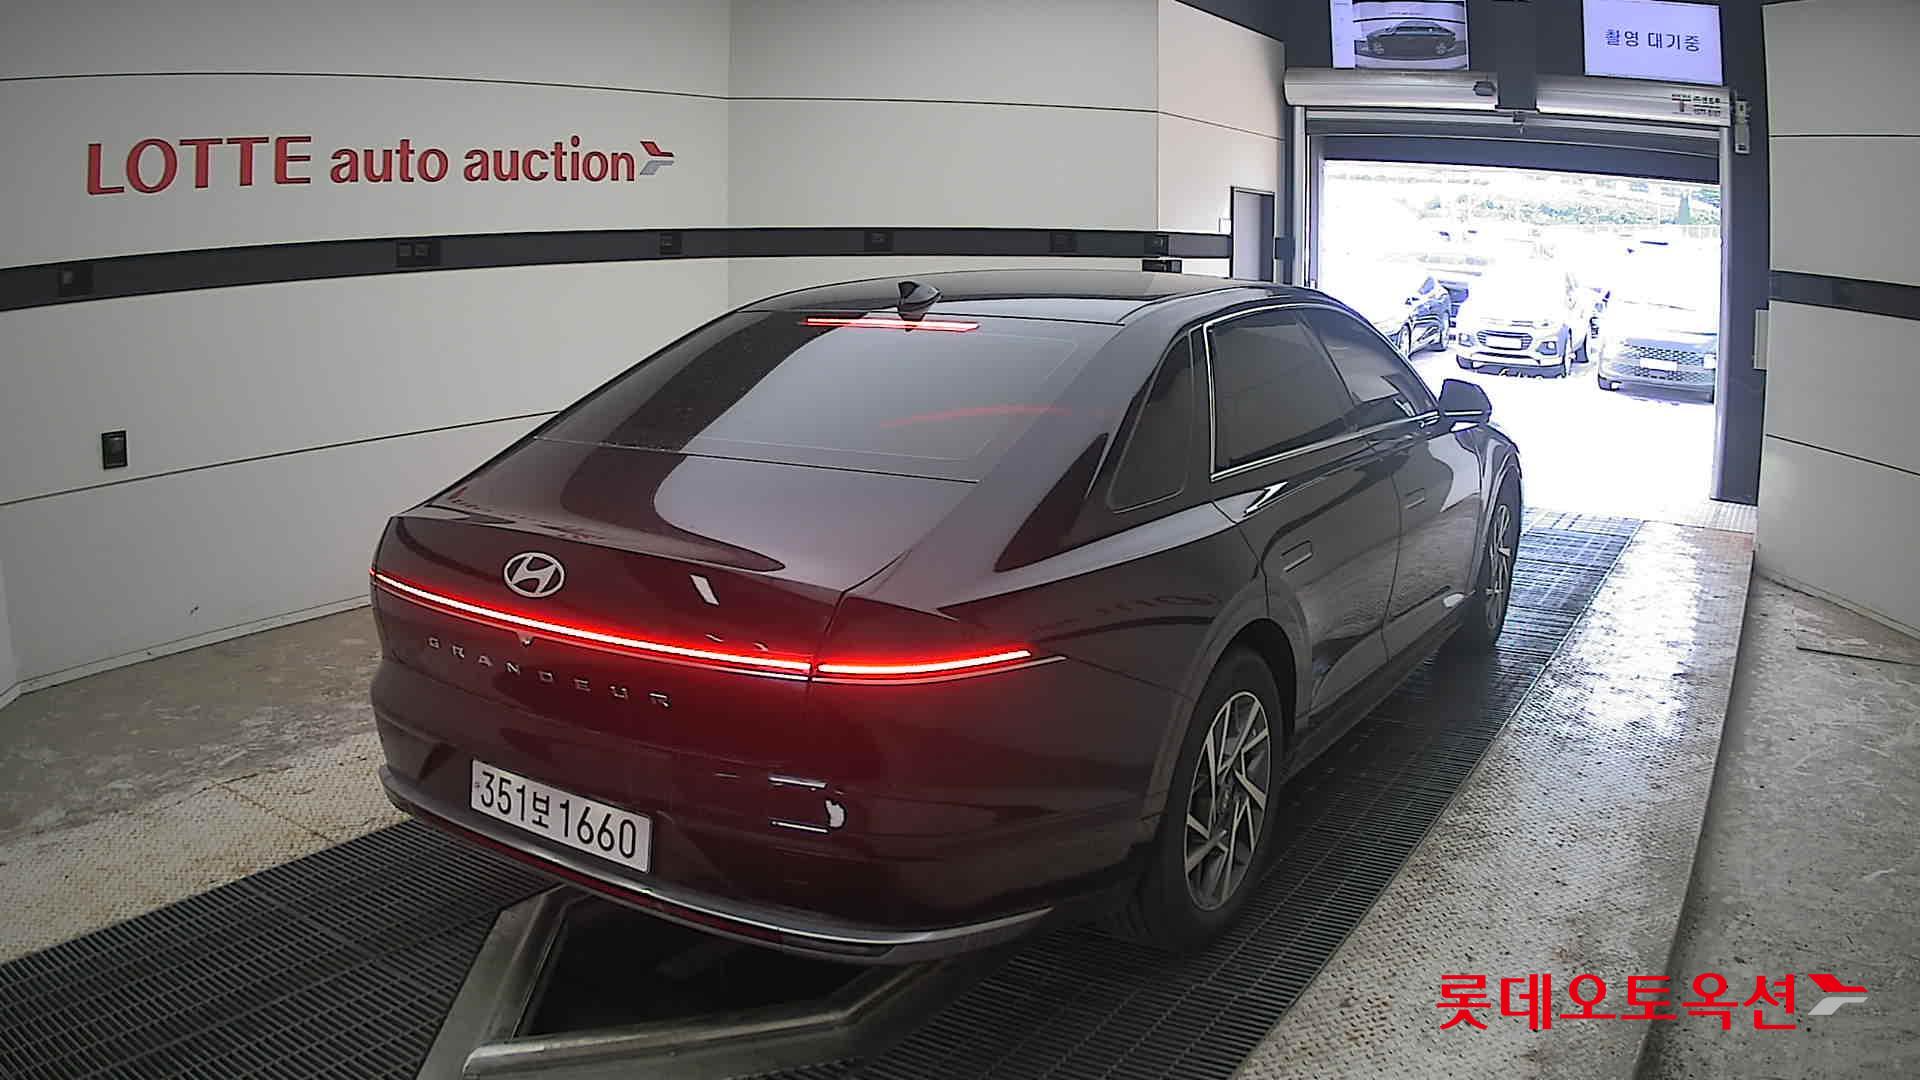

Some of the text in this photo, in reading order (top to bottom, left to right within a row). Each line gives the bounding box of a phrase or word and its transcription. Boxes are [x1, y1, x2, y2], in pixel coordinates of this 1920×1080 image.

[1647, 31, 1701, 53] 대기중
[87, 135, 637, 196] LOTTE auto auction
[426, 636, 673, 709] GRANDEUR
